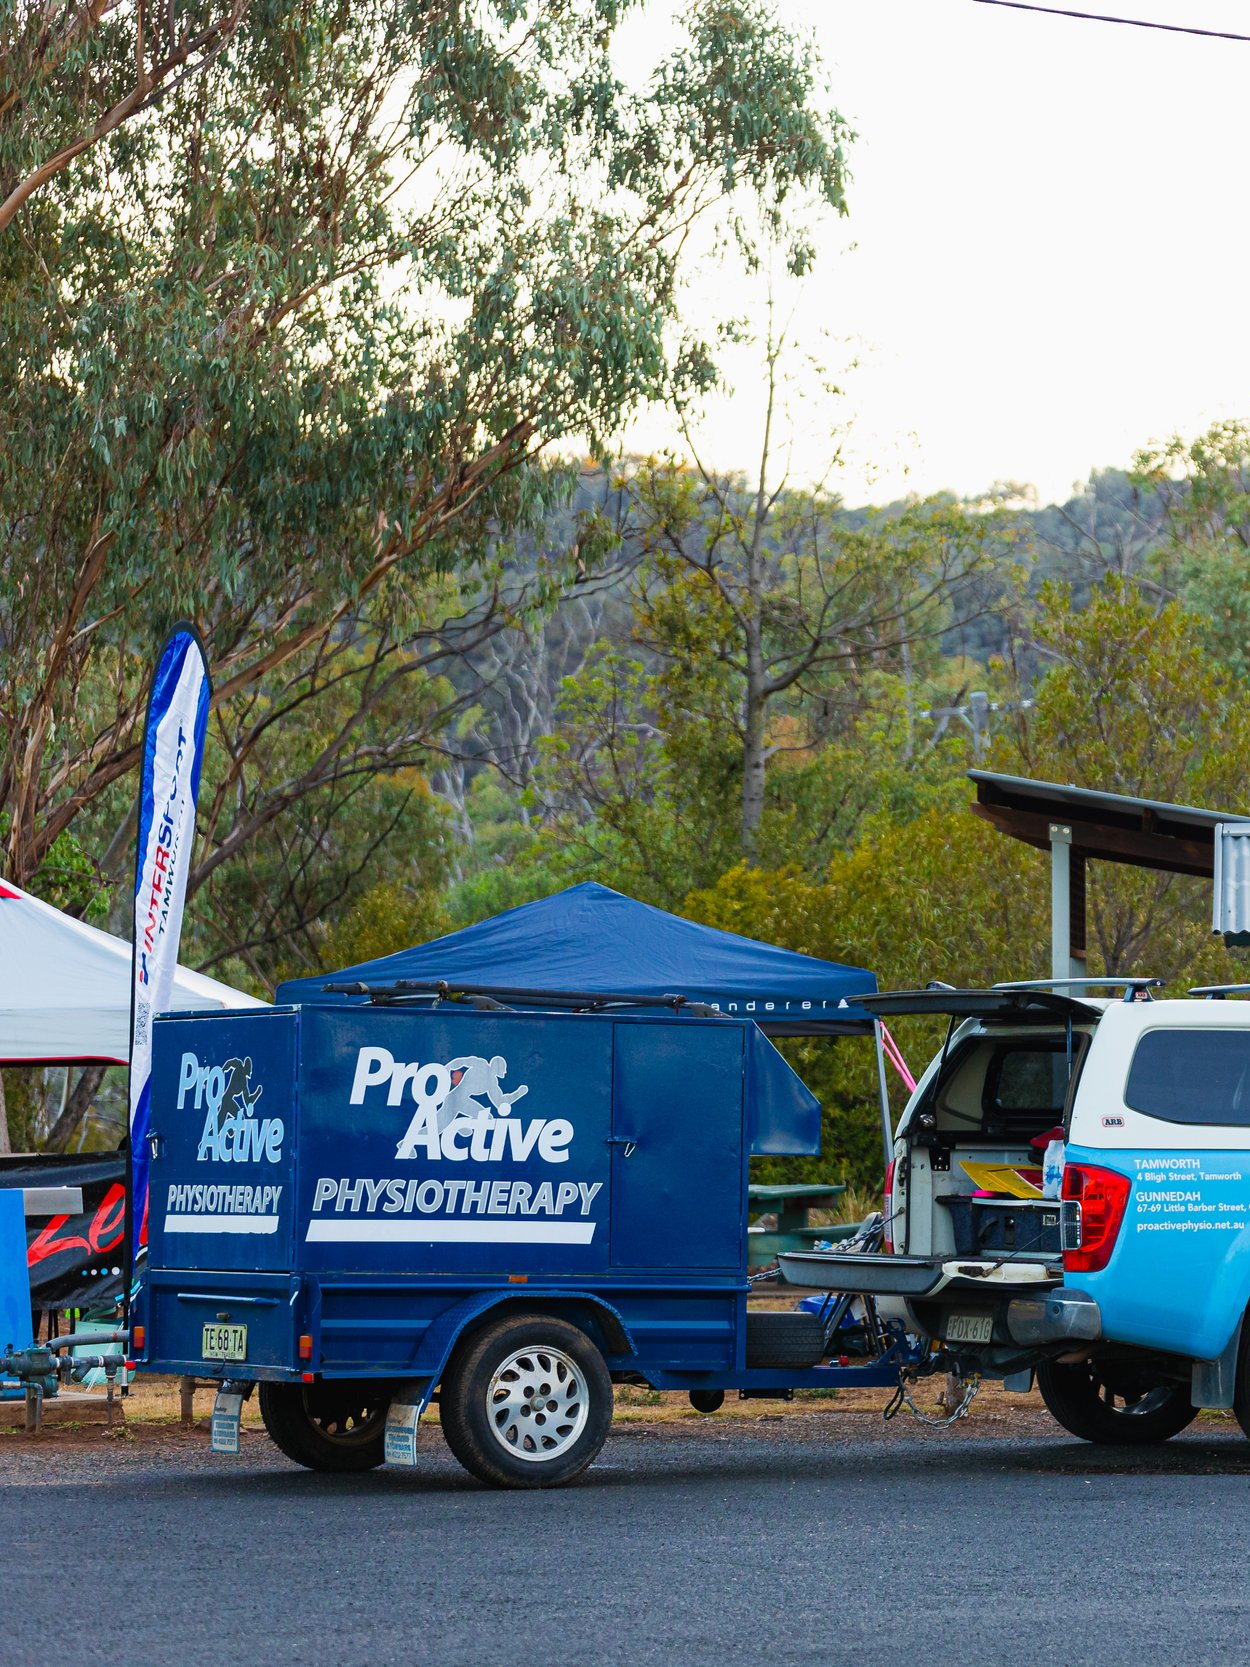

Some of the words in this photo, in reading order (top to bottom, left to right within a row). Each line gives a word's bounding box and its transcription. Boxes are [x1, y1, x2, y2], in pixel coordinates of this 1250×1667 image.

[176, 1052, 226, 1110] Pro
[349, 1046, 452, 1107] Pro
[197, 1101, 285, 1163] Active
[394, 1100, 574, 1163] Active
[1134, 1159, 1201, 1170] TAMWORTH
[1136, 1172, 1143, 1181] 4
[1145, 1172, 1167, 1184] Bligh
[1168, 1171, 1198, 1182] Street,
[1199, 1171, 1242, 1181] Tamworth
[167, 1184, 283, 1214] PHYSIOTHERAPY
[312, 1177, 604, 1216] PHYSIOTHERAPY
[1135, 1191, 1201, 1202] GUNNEDAH
[1136, 1204, 1161, 1213] 67-69
[1163, 1203, 1186, 1213] Little
[1187, 1203, 1217, 1212] Barber
[1218, 1203, 1247, 1213] Street,
[1136, 1219, 1245, 1233] proactivephysio.net.au
